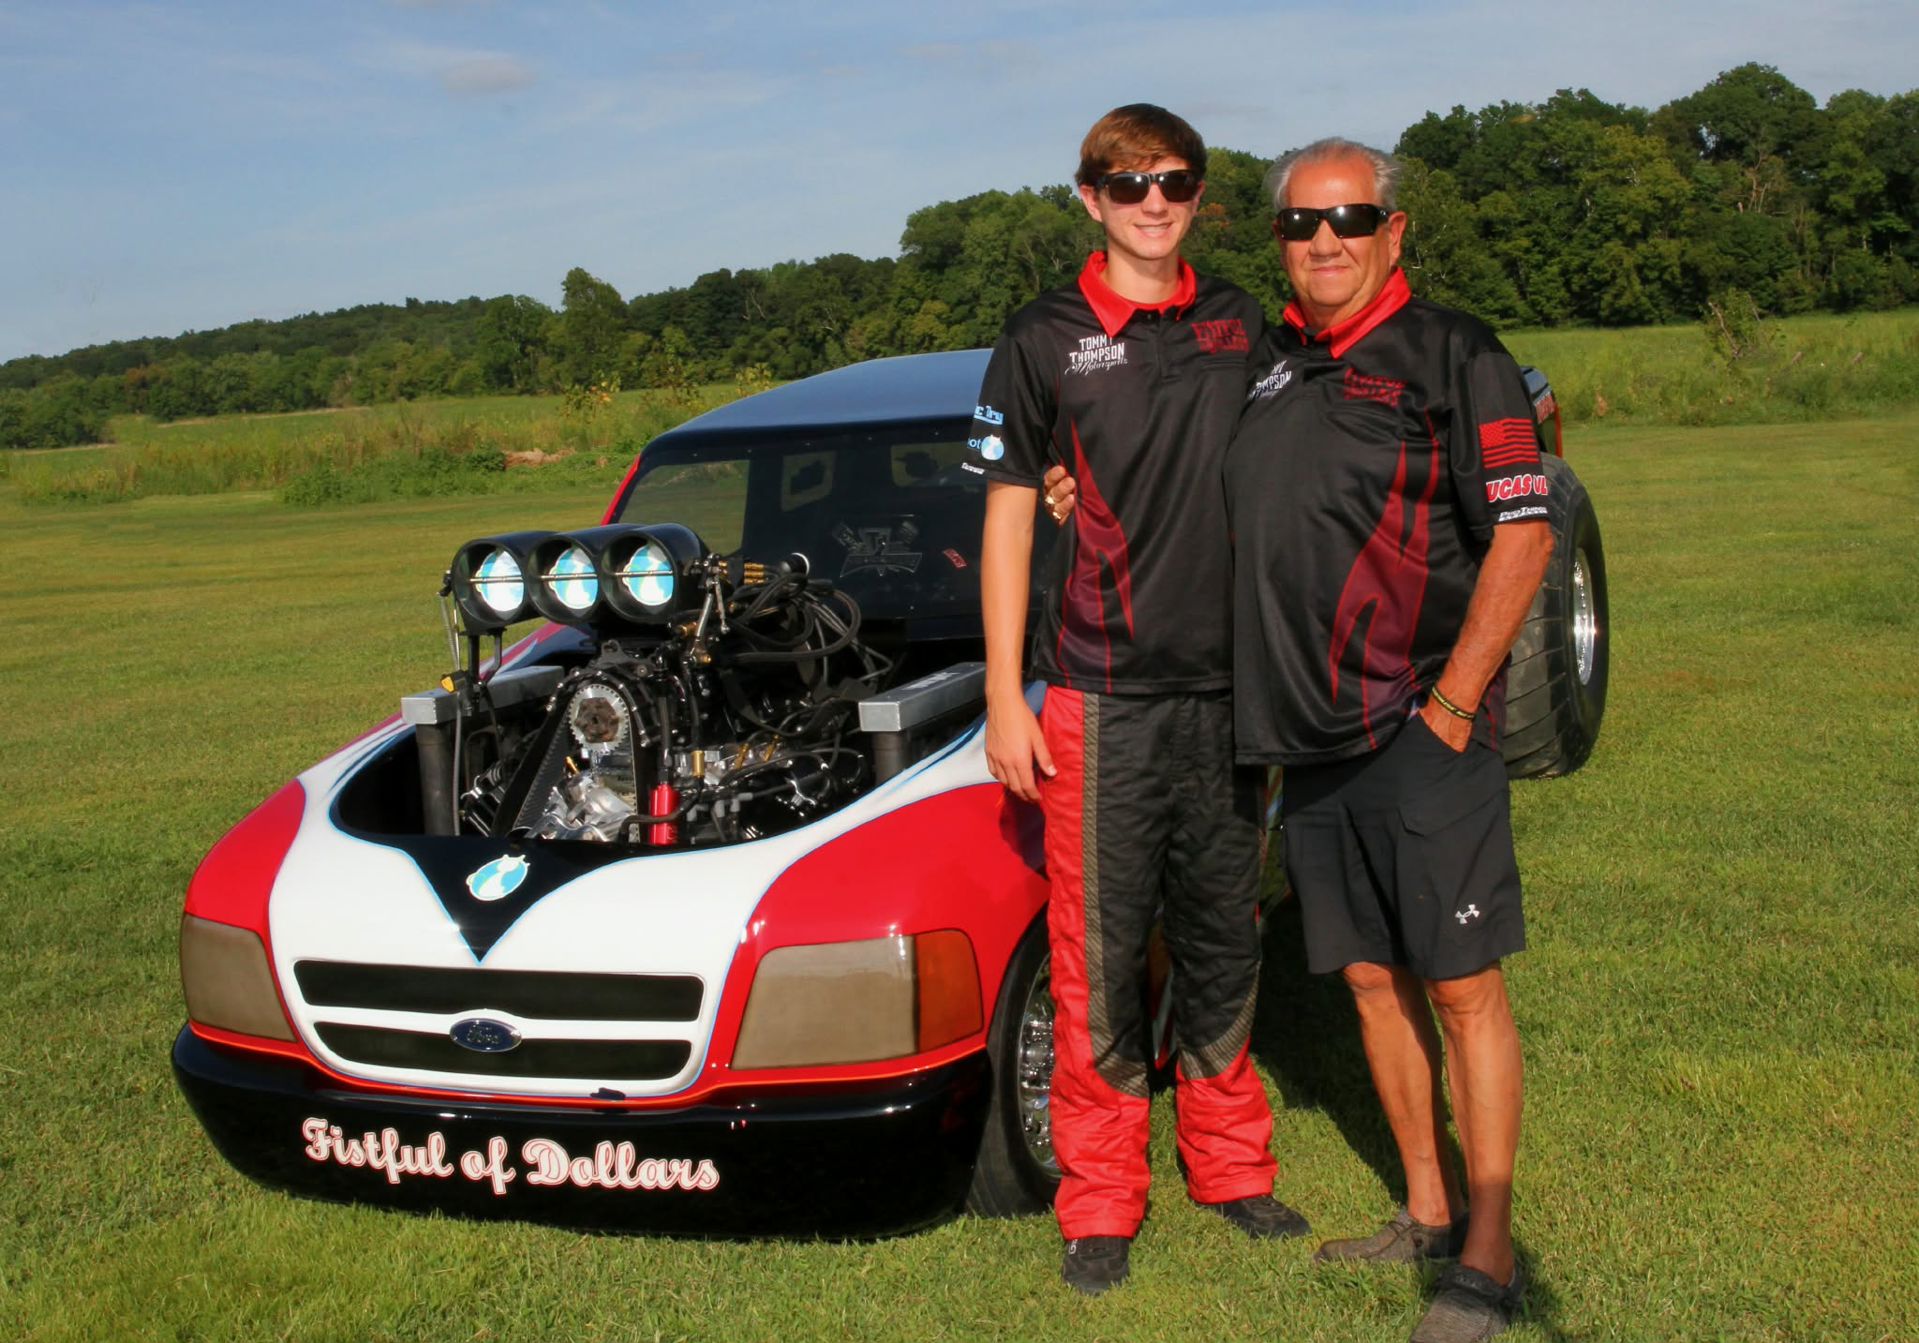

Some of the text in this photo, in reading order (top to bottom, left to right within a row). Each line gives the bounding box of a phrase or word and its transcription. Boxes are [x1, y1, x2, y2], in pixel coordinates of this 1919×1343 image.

[1069, 342, 1125, 363] THOMPSON
[1486, 474, 1533, 503] UCAS
[302, 1116, 720, 1195] Fistful of Dollars
